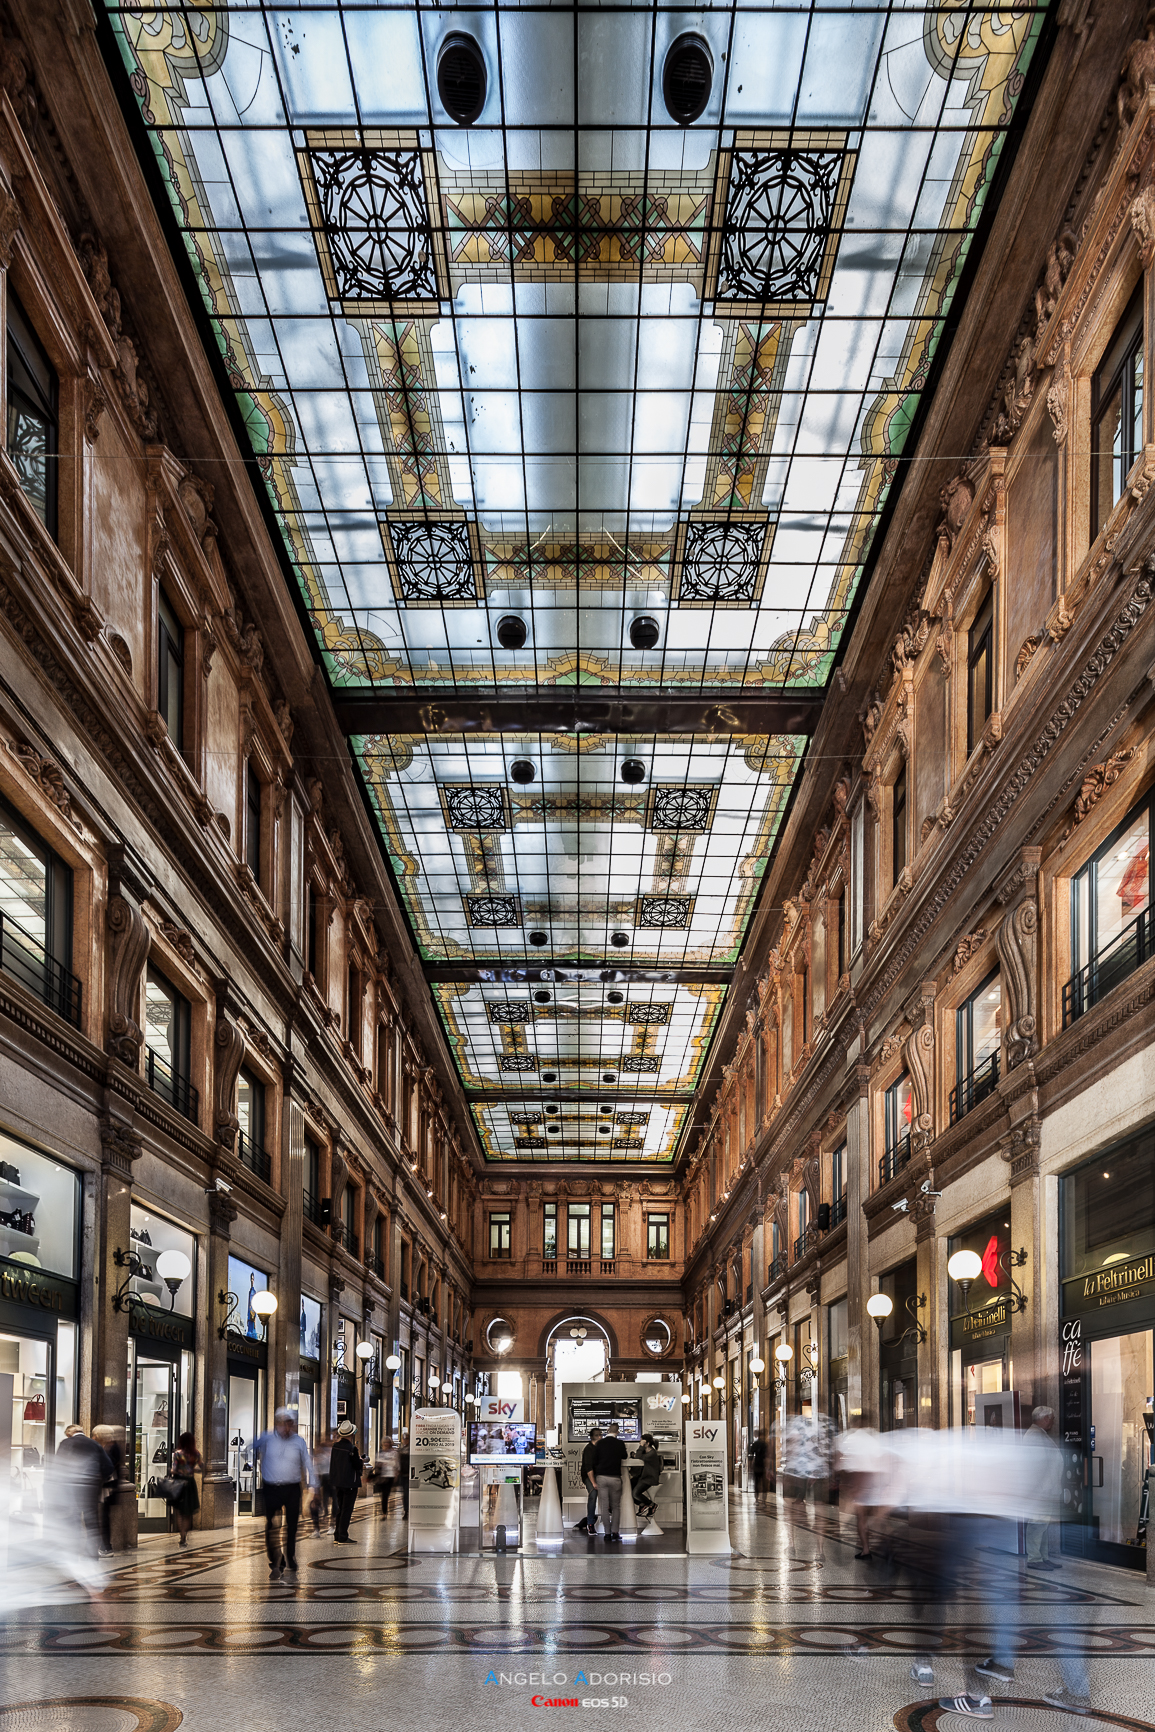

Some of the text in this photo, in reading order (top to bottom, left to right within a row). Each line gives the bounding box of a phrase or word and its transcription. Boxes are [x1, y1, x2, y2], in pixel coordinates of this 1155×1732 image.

[1083, 1257, 1155, 1296] la Feltrinell
[1117, 1289, 1141, 1302] Musica
[149, 1314, 185, 1343] tween
[228, 1341, 260, 1358] COCCINELLE
[488, 1399, 518, 1419] sky
[647, 1393, 676, 1412] sky
[693, 1426, 718, 1442] sky
